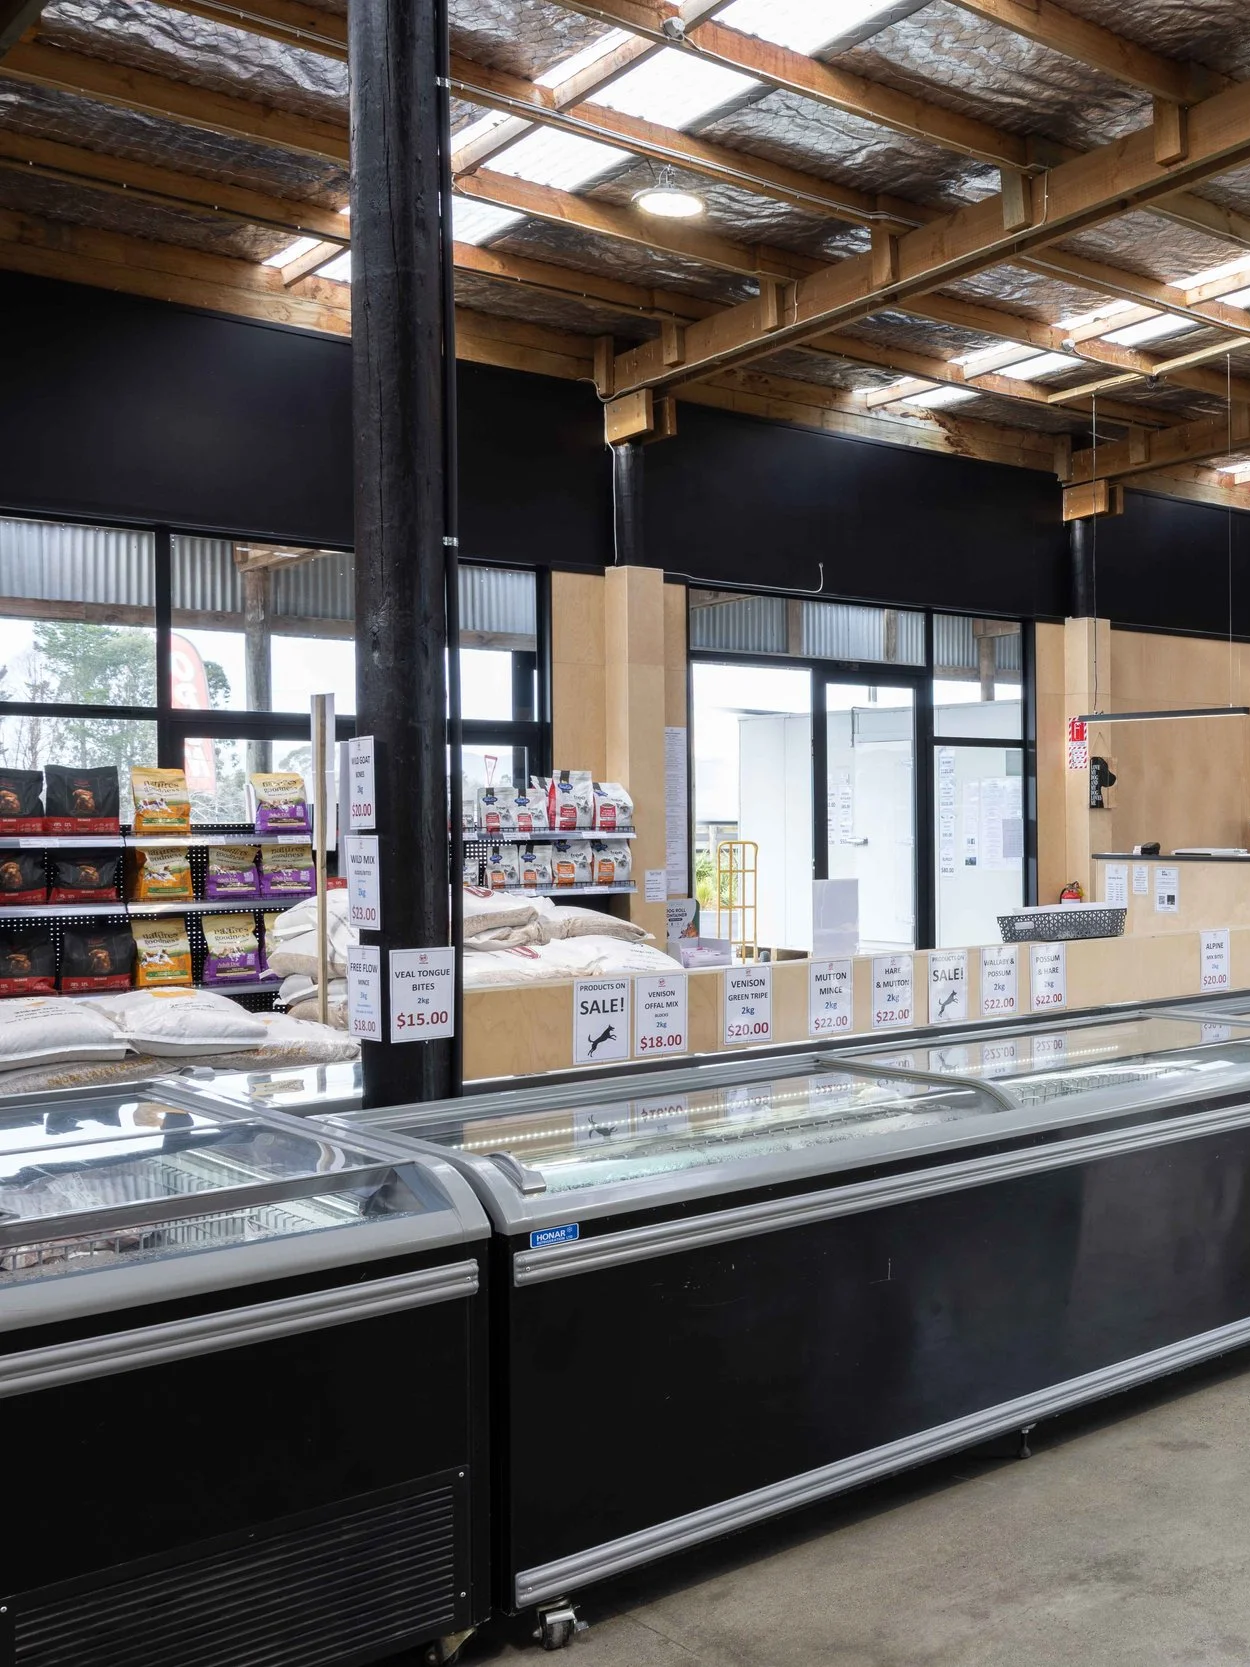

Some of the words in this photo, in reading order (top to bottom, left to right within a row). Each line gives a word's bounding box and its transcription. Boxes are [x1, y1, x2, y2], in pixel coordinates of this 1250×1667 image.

[359, 755, 371, 764] GOAT
[352, 803, 372, 819] $20.00
[350, 854, 362, 864] WILD
[363, 854, 376, 865] MIX
[352, 907, 376, 921] $23.00
[1205, 942, 1224, 950] ALPINE
[1035, 954, 1061, 964] POSSUM
[350, 962, 362, 973] FREE
[362, 963, 378, 974] FLOW
[395, 970, 416, 979] VEAL
[417, 968, 451, 978] TONGUE
[884, 966, 902, 975] HARE
[987, 969, 1012, 978] POSSUM
[1043, 966, 1060, 974] HARE
[814, 971, 847, 982] MUTTON
[932, 966, 965, 982] SALE!
[731, 979, 766, 989] VENISON
[875, 981, 881, 989] &
[882, 978, 910, 988] MUTTON
[1203, 974, 1227, 986] $20.00
[412, 983, 435, 992] BITES
[579, 983, 614, 992] PRODUCTS
[819, 986, 843, 996] MINCE
[993, 982, 1006, 992] 2kg
[648, 990, 676, 998] VENISON
[728, 993, 749, 1002] GREEN
[750, 991, 769, 1000] TRIPE
[886, 993, 900, 1004] 2kg
[1035, 993, 1063, 1006] $22.00
[417, 997, 430, 1005] 2kg
[580, 997, 625, 1016] SALE!
[644, 1002, 665, 1010] OFFAL
[824, 1001, 838, 1011] 2kg
[984, 997, 1015, 1010] $22.00
[741, 1006, 755, 1016] 2kg
[876, 1008, 910, 1023] $22.00
[397, 1010, 449, 1029] $15.00
[656, 1020, 668, 1029] 2kg
[814, 1015, 848, 1030] $22.00
[354, 1019, 376, 1033] $18.00
[727, 1021, 769, 1038] $20.00
[640, 1034, 682, 1050] $18.00
[536, 1230, 566, 1241] HONAR
